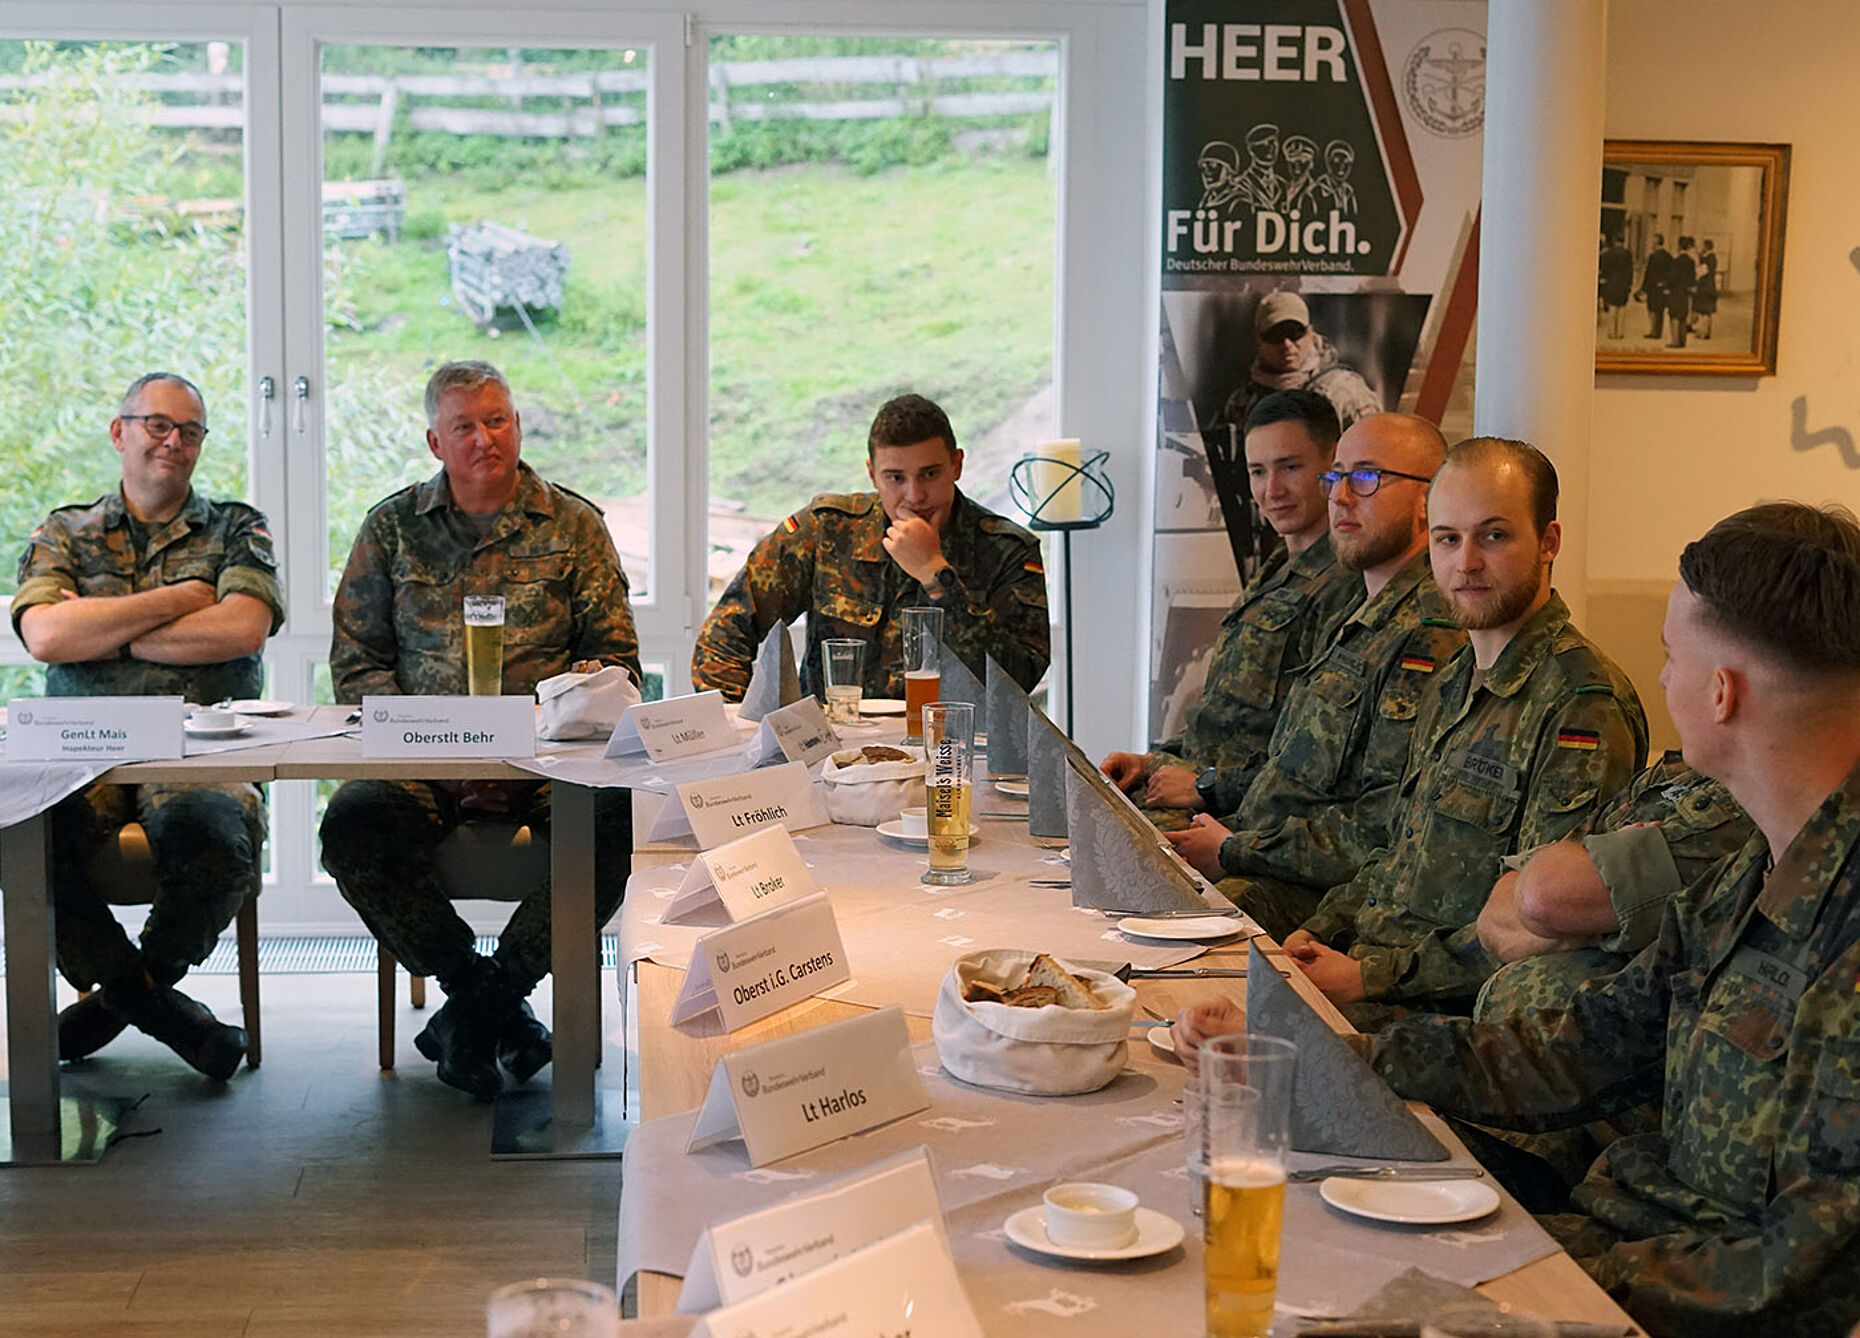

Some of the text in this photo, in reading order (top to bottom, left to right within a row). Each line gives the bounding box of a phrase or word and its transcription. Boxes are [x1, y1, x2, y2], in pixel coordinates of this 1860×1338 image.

[1170, 23, 1347, 82] HEER
[1167, 209, 1371, 254] Für Dich.
[1166, 257, 1227, 271] Deutscher
[61, 729, 127, 740] GenLt Mais
[463, 731, 495, 743] Behr
[935, 739, 953, 777] Weisse
[731, 805, 788, 827] Lt Fröhlich
[733, 952, 834, 1005] Oberst i.G. Carstens
[802, 1088, 867, 1123] Lt Harlos
